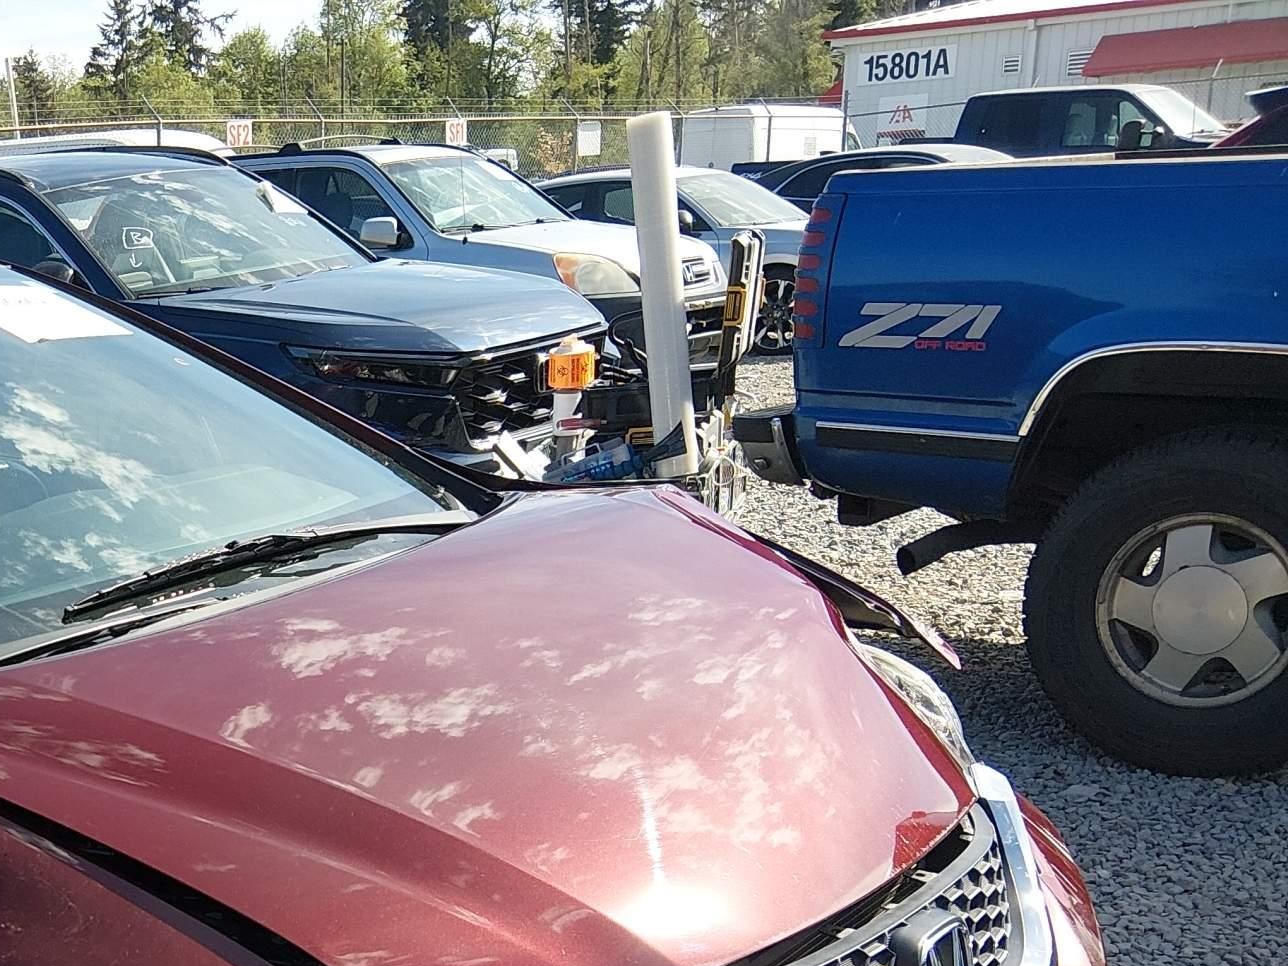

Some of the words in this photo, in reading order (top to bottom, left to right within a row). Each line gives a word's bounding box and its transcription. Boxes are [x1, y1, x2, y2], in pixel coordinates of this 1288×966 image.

[864, 48, 949, 82] 15801A
[229, 124, 249, 146] SF2
[449, 122, 464, 143] SF1
[838, 302, 1002, 348] Z71
[914, 340, 942, 350] OFF
[945, 341, 986, 351] ROAD
